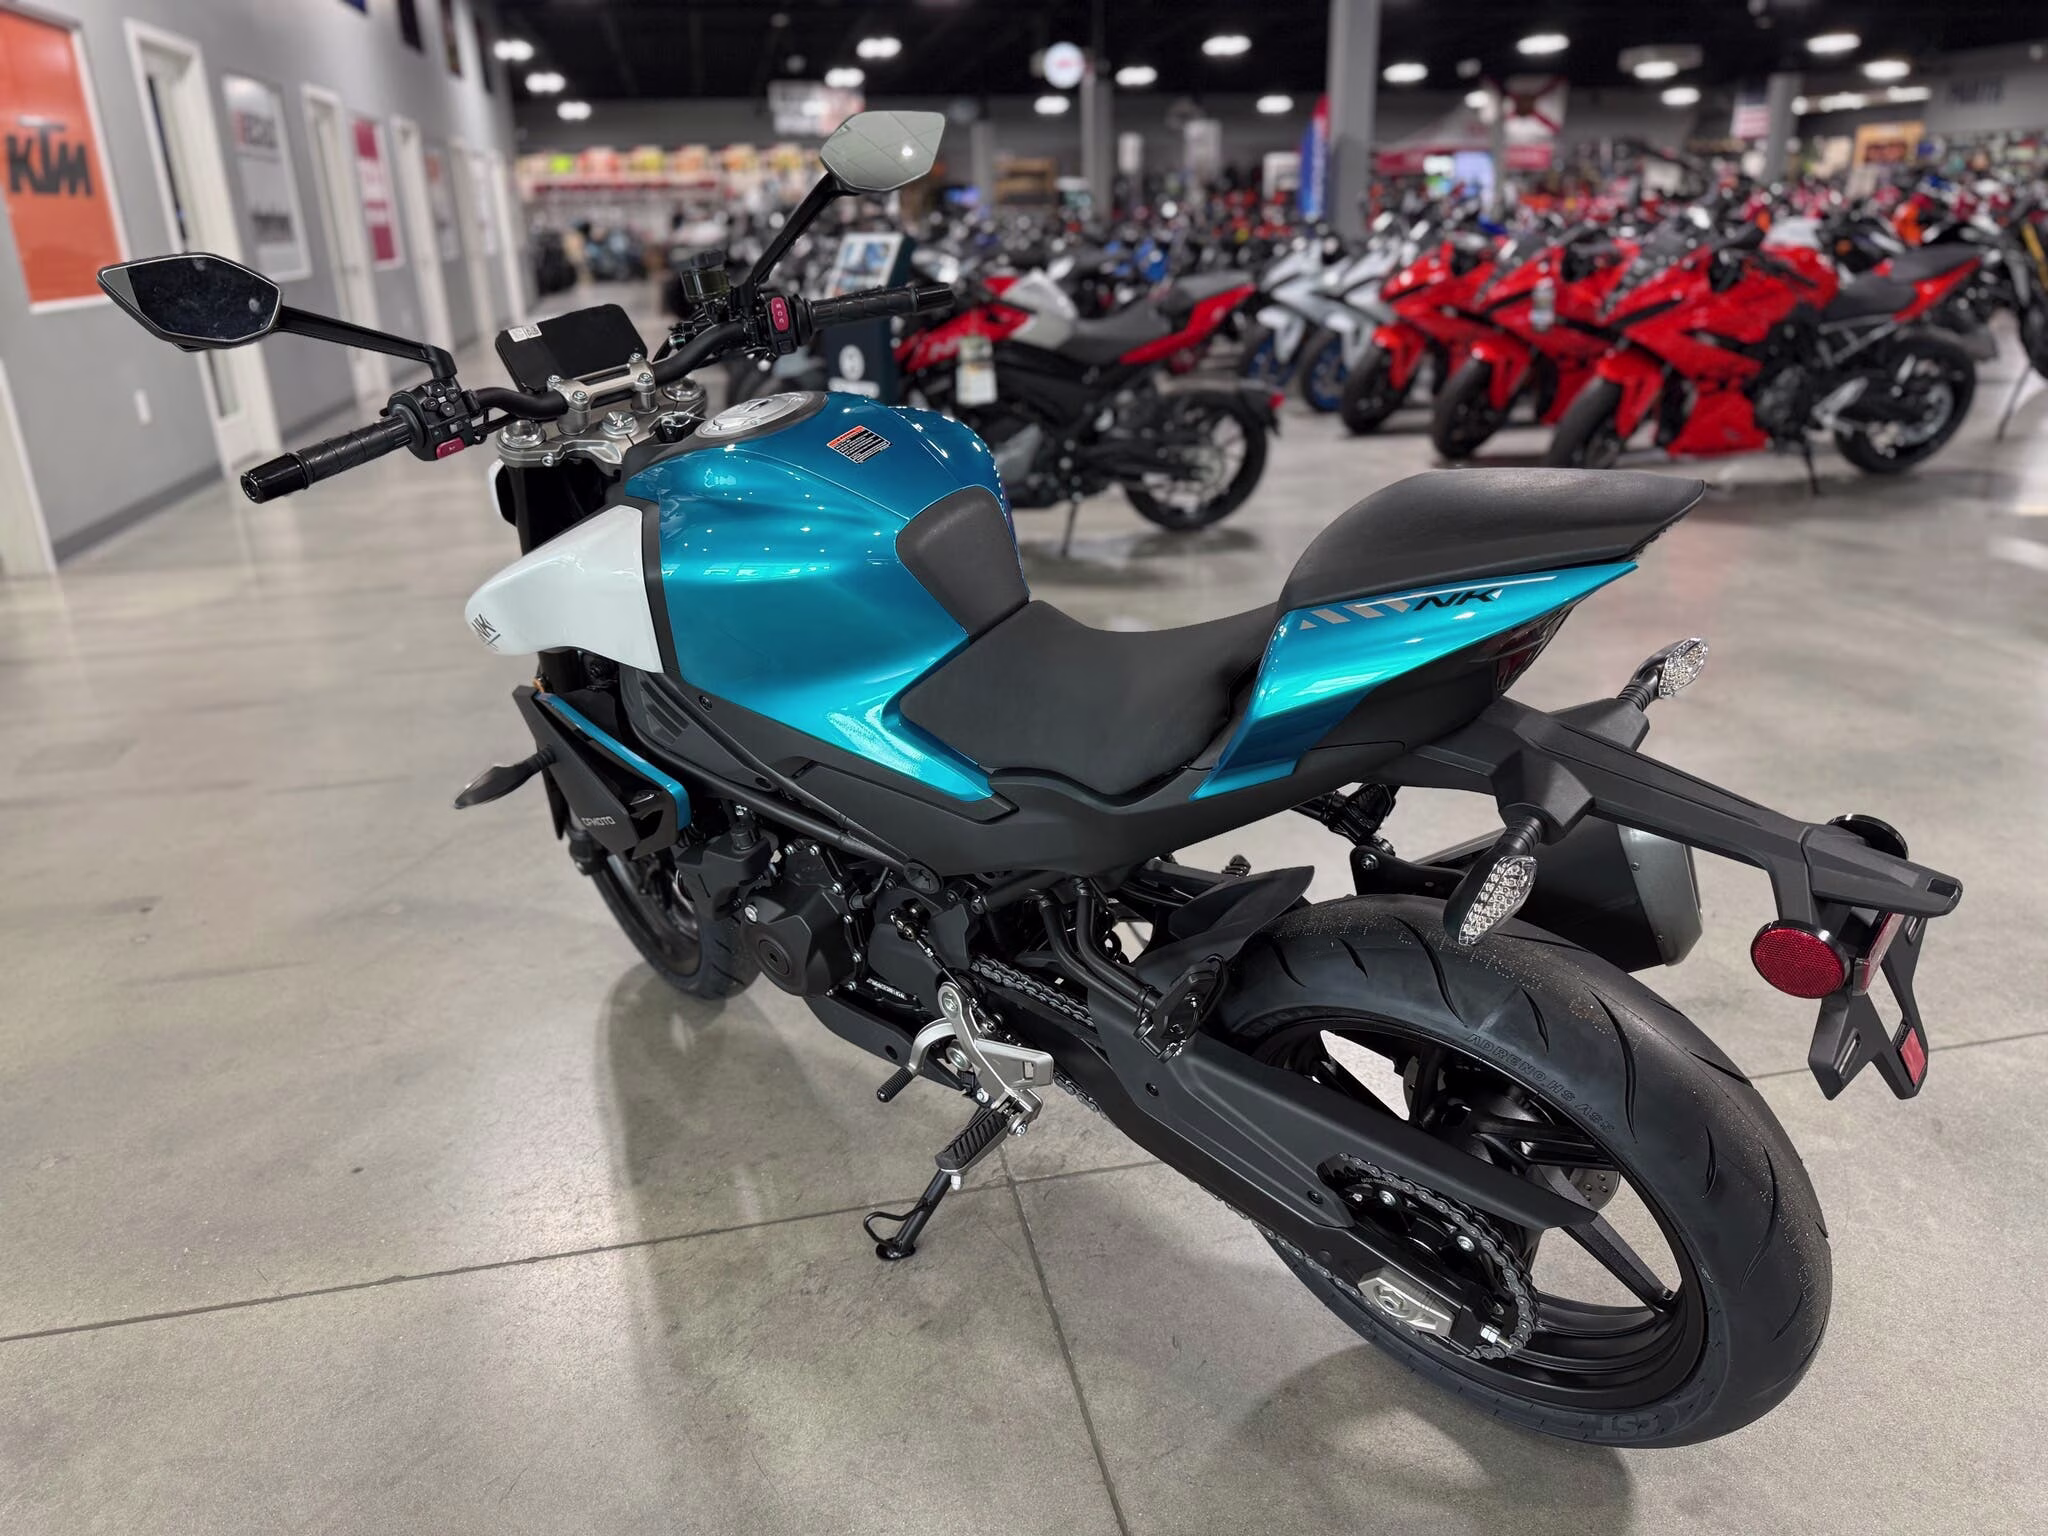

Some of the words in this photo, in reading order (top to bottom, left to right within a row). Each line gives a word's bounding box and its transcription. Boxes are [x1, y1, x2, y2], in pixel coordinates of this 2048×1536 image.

[6, 119, 94, 197] KTM
[1413, 588, 1502, 611] NK
[1595, 1413, 1659, 1438] CST
